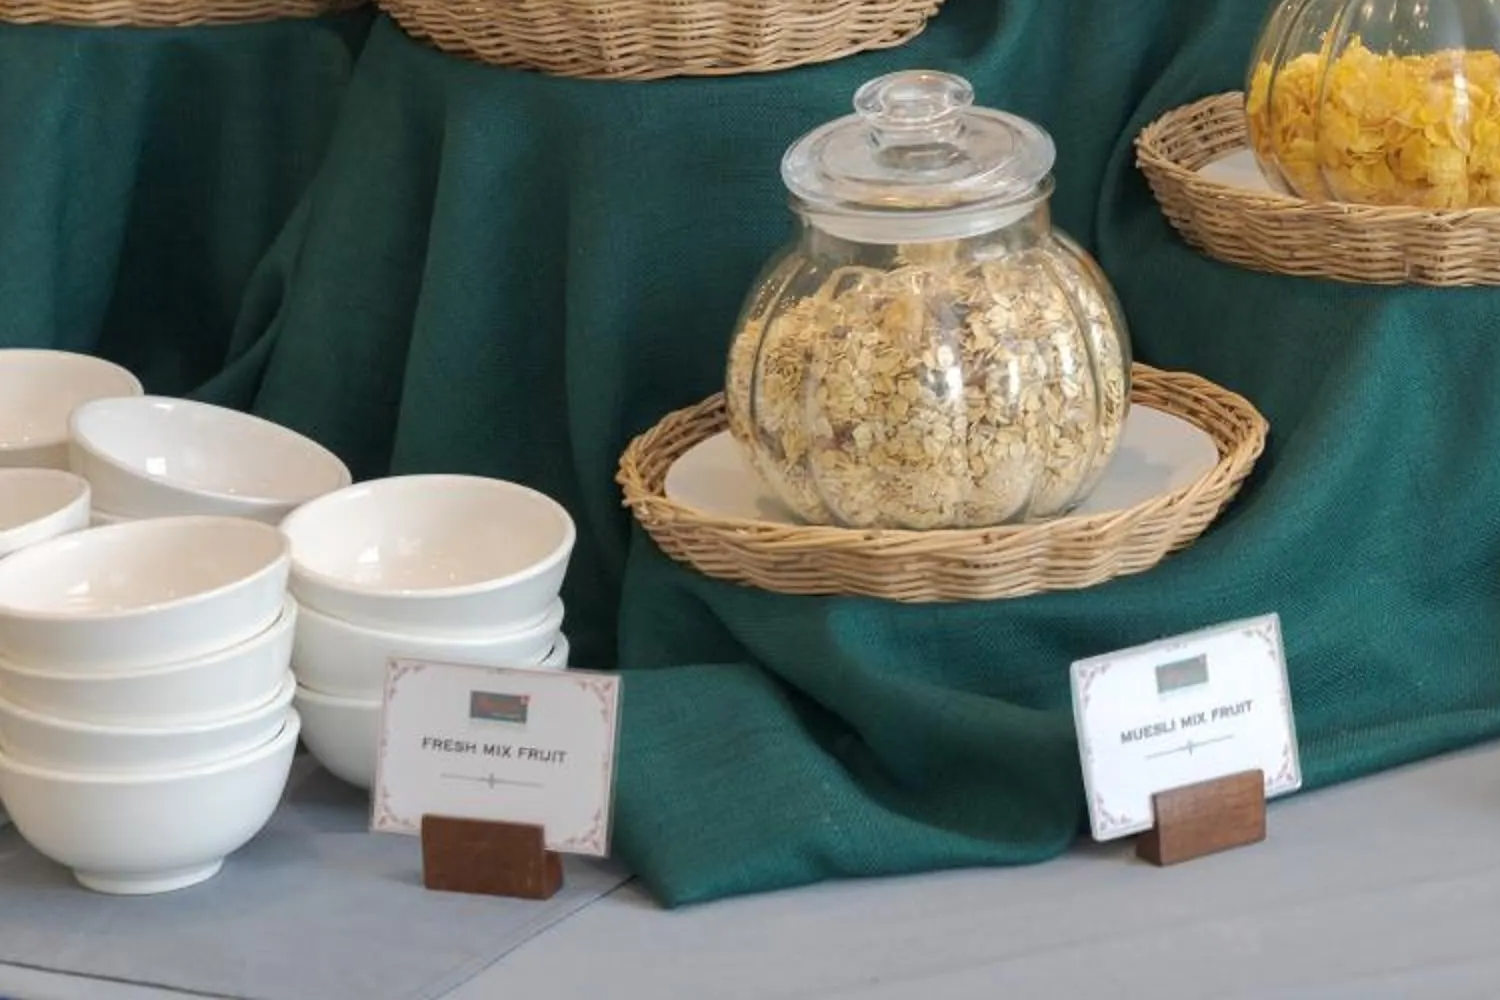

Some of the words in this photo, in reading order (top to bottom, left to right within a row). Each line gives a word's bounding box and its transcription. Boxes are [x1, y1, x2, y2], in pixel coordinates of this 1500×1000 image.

[1120, 719, 1177, 744] MUESLI
[1181, 713, 1206, 729] MIX
[1211, 699, 1254, 722] FRUIT
[421, 737, 477, 755] FRESH
[483, 743, 512, 759] MIX
[517, 747, 568, 764] FRUIT
